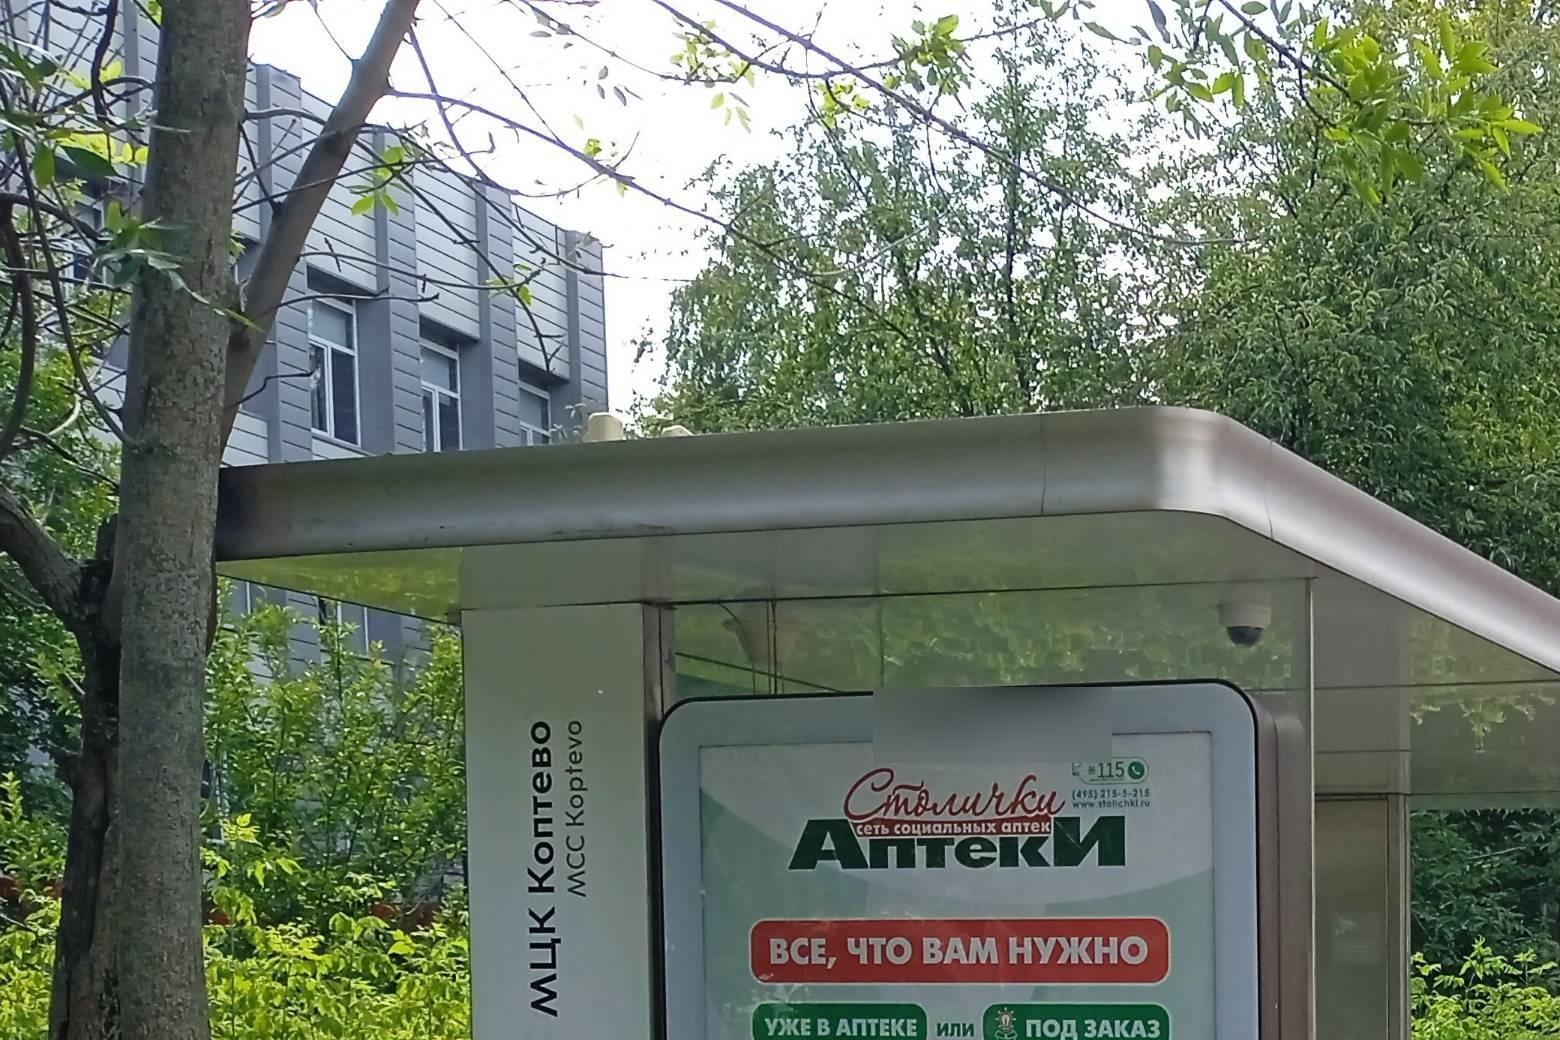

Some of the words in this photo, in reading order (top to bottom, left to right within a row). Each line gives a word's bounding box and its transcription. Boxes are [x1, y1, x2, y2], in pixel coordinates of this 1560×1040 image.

[564, 720, 588, 828] Koptevo
[843, 766, 1066, 821] Столички
[1072, 789, 1098, 800] (495)
[1100, 788, 1150, 799] 215-5-215
[527, 719, 555, 894] Коптево
[856, 823, 889, 836] сеть
[894, 821, 997, 836] социальных
[1002, 820, 1050, 834] аптек
[566, 835, 586, 897] MCC
[528, 906, 561, 1018] МЦК
[769, 937, 837, 969] ВСЕ,
[847, 937, 912, 965] ЧТО
[923, 937, 998, 965] ВАМ
[1008, 936, 1149, 965] НУЖНО
[764, 1017, 811, 1037] УЖЕ
[817, 1018, 833, 1036] В
[836, 1017, 918, 1038] АПТЕКЕ
[936, 1023, 975, 1038] ИЛИ
[1026, 1018, 1077, 1040] ПОД
[1084, 1018, 1160, 1039] ЗАКАЗ
